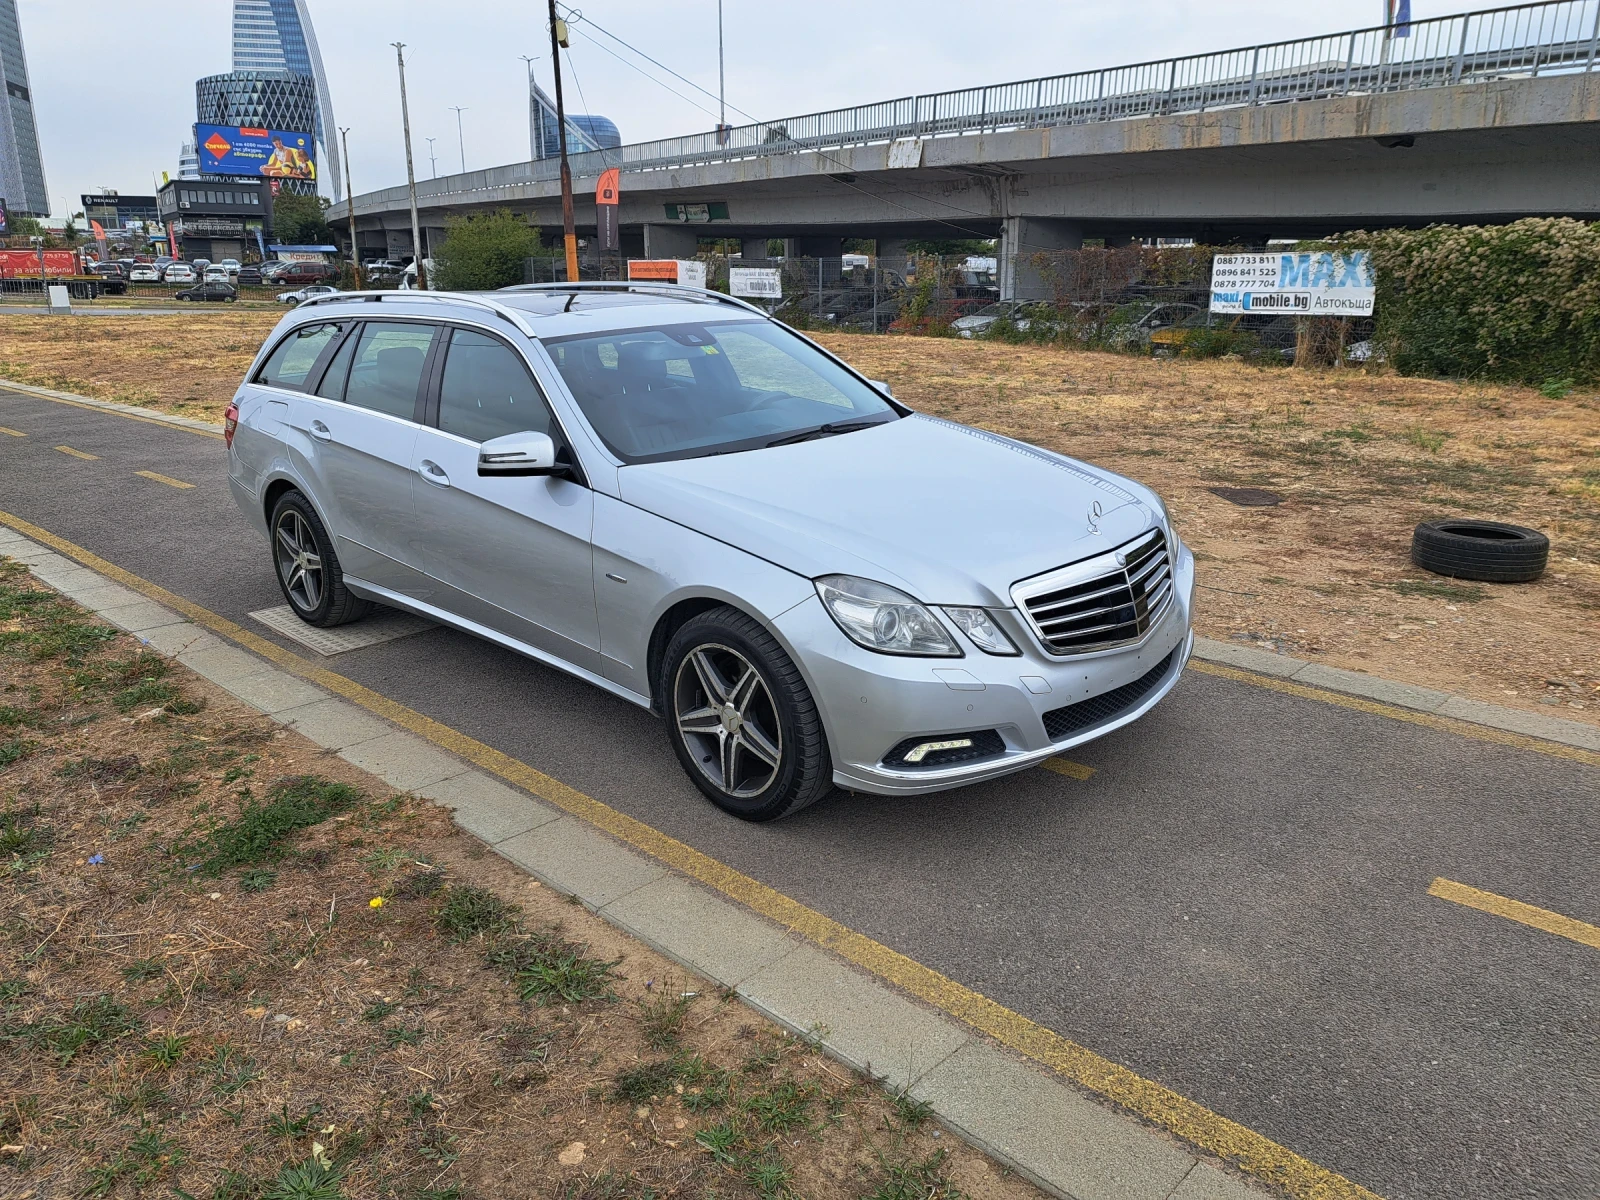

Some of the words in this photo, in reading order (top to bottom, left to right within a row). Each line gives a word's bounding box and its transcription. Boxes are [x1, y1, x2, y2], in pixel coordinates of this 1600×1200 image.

[1216, 256, 1239, 265] 0887
[1240, 256, 1257, 265] 733
[1259, 256, 1276, 264] 811
[1215, 268, 1238, 277] 0896
[1240, 268, 1256, 276] 841
[1259, 268, 1277, 276] 525
[1213, 280, 1237, 288] 0878
[1239, 280, 1257, 288] 777
[1258, 280, 1276, 288] 704
[1251, 293, 1309, 309] mobile.bg
[1314, 295, 1372, 311] Автокъща
